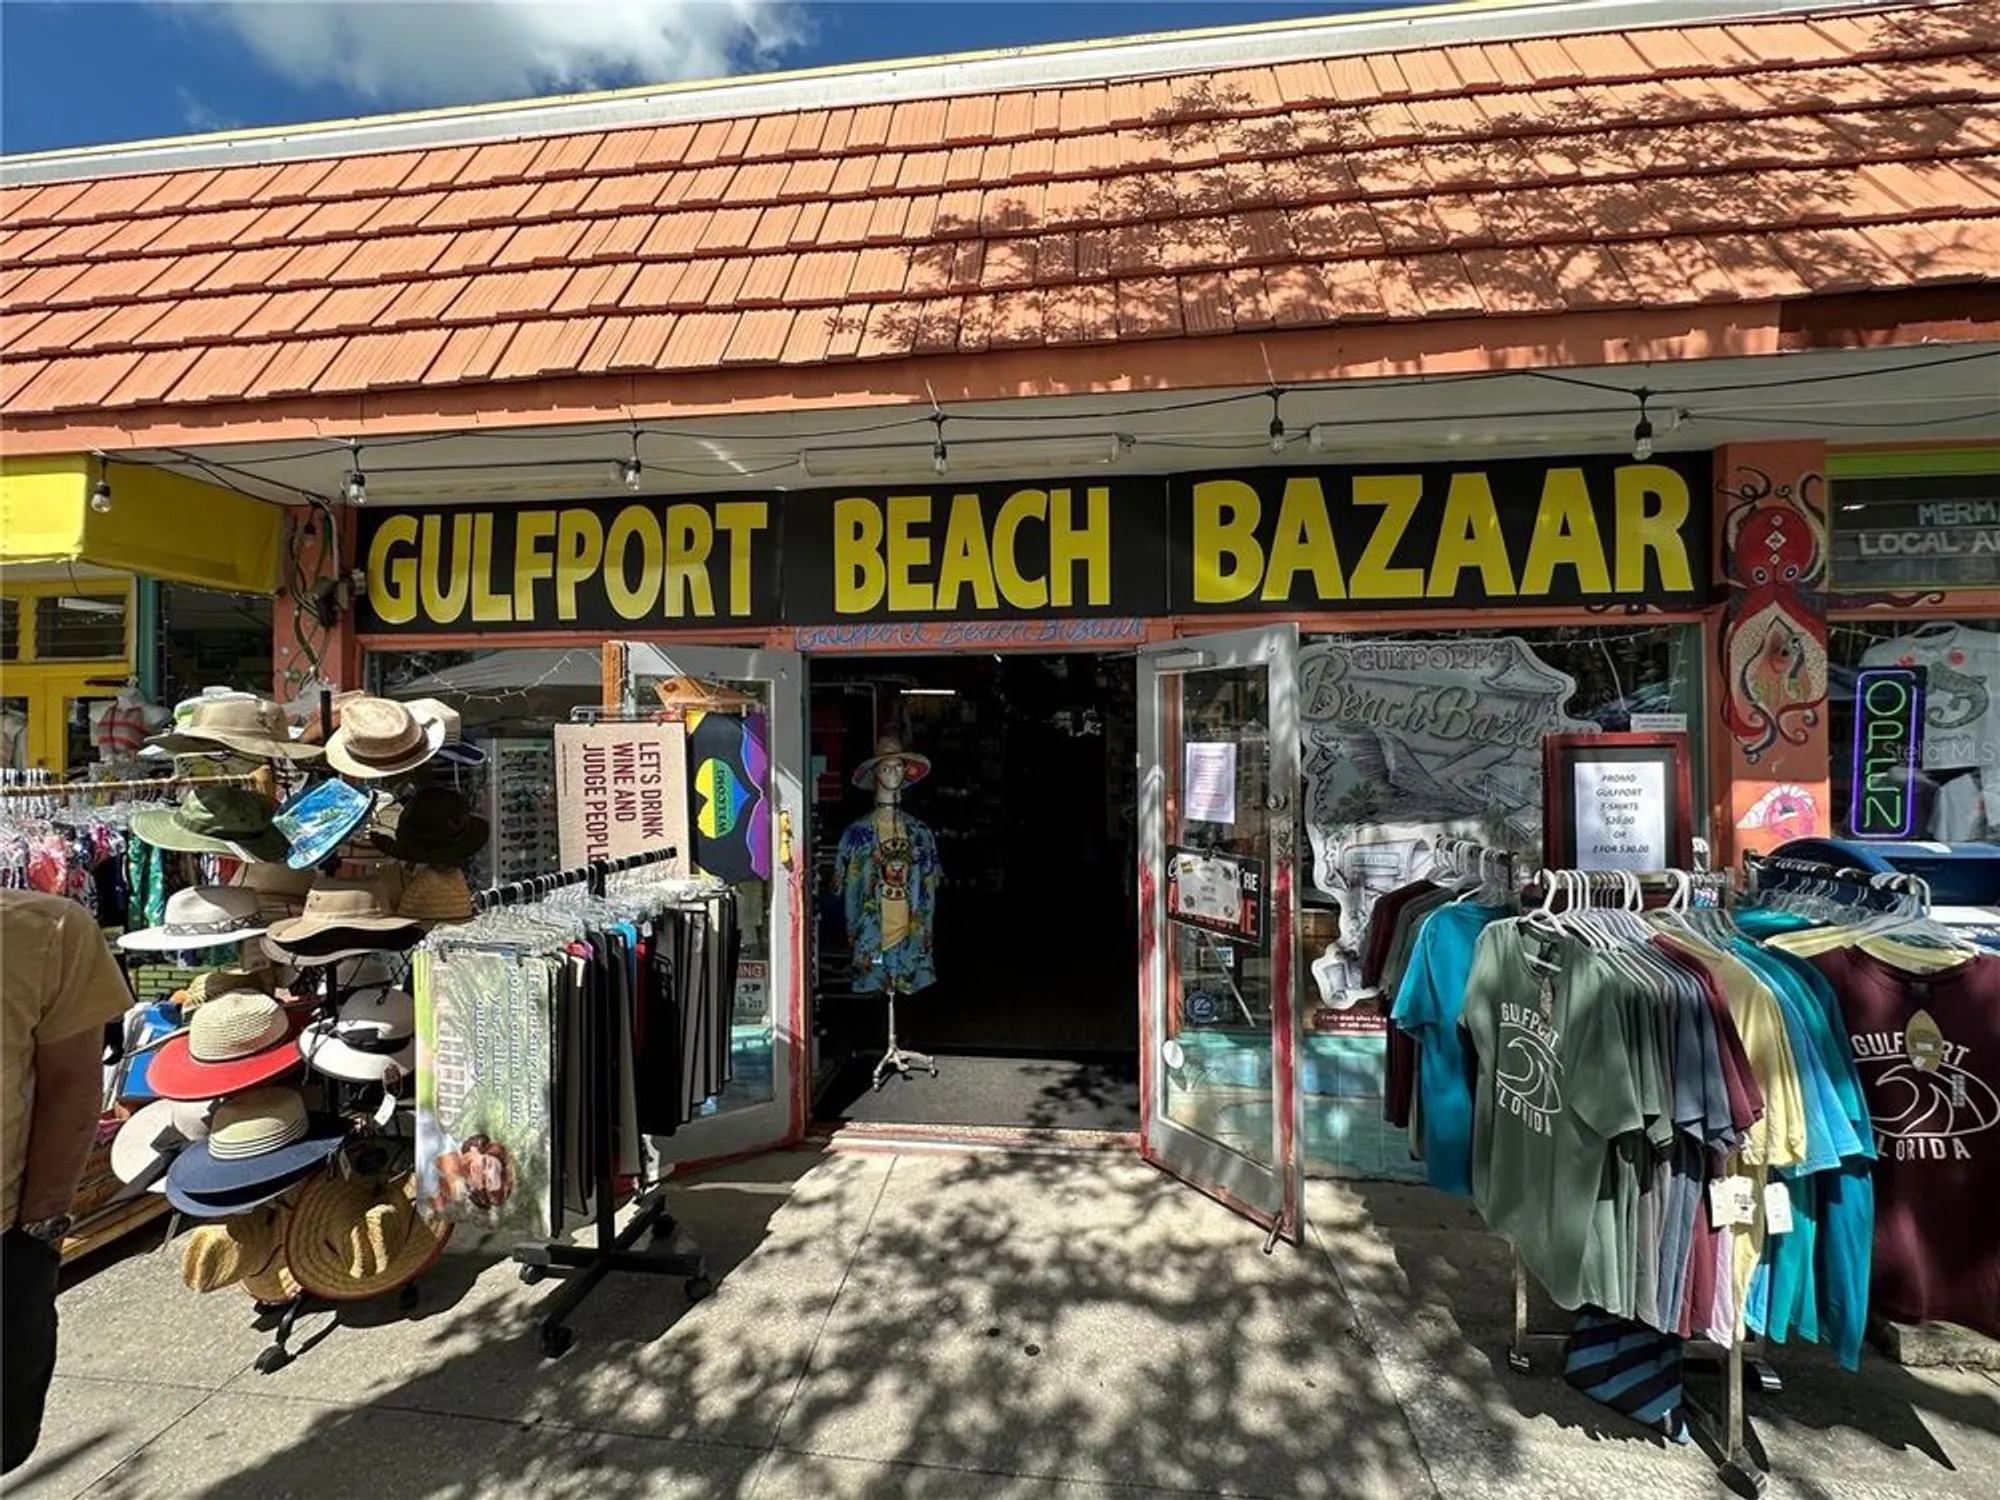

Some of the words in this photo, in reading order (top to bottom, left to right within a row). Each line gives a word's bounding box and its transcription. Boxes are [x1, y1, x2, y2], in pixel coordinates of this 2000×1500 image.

[1919, 500, 2000, 525] MERM
[368, 502, 767, 625] GULFPORT
[834, 487, 1110, 613] BEACH
[1193, 464, 1694, 603] BAZAAR
[1859, 531, 1959, 556] LOCAL
[1299, 653, 1427, 733] Beach
[1430, 687, 1543, 750] Baza
[583, 744, 607, 797] JUDGE
[613, 742, 635, 785] WINE
[639, 742, 661, 785] LET'S
[1864, 680, 1906, 829] OPEN
[1596, 788, 1643, 797] GULFPORT
[1601, 774, 1636, 783] PROMO
[614, 789, 636, 822] AND
[641, 790, 664, 839] DRINK
[586, 800, 609, 863] PEOPLE
[1613, 831, 1628, 839] OR
[1500, 1002, 1560, 1049] GUFPRT
[1851, 1031, 1970, 1066] GULFRT
[1878, 1135, 1972, 1161] LORIDA
